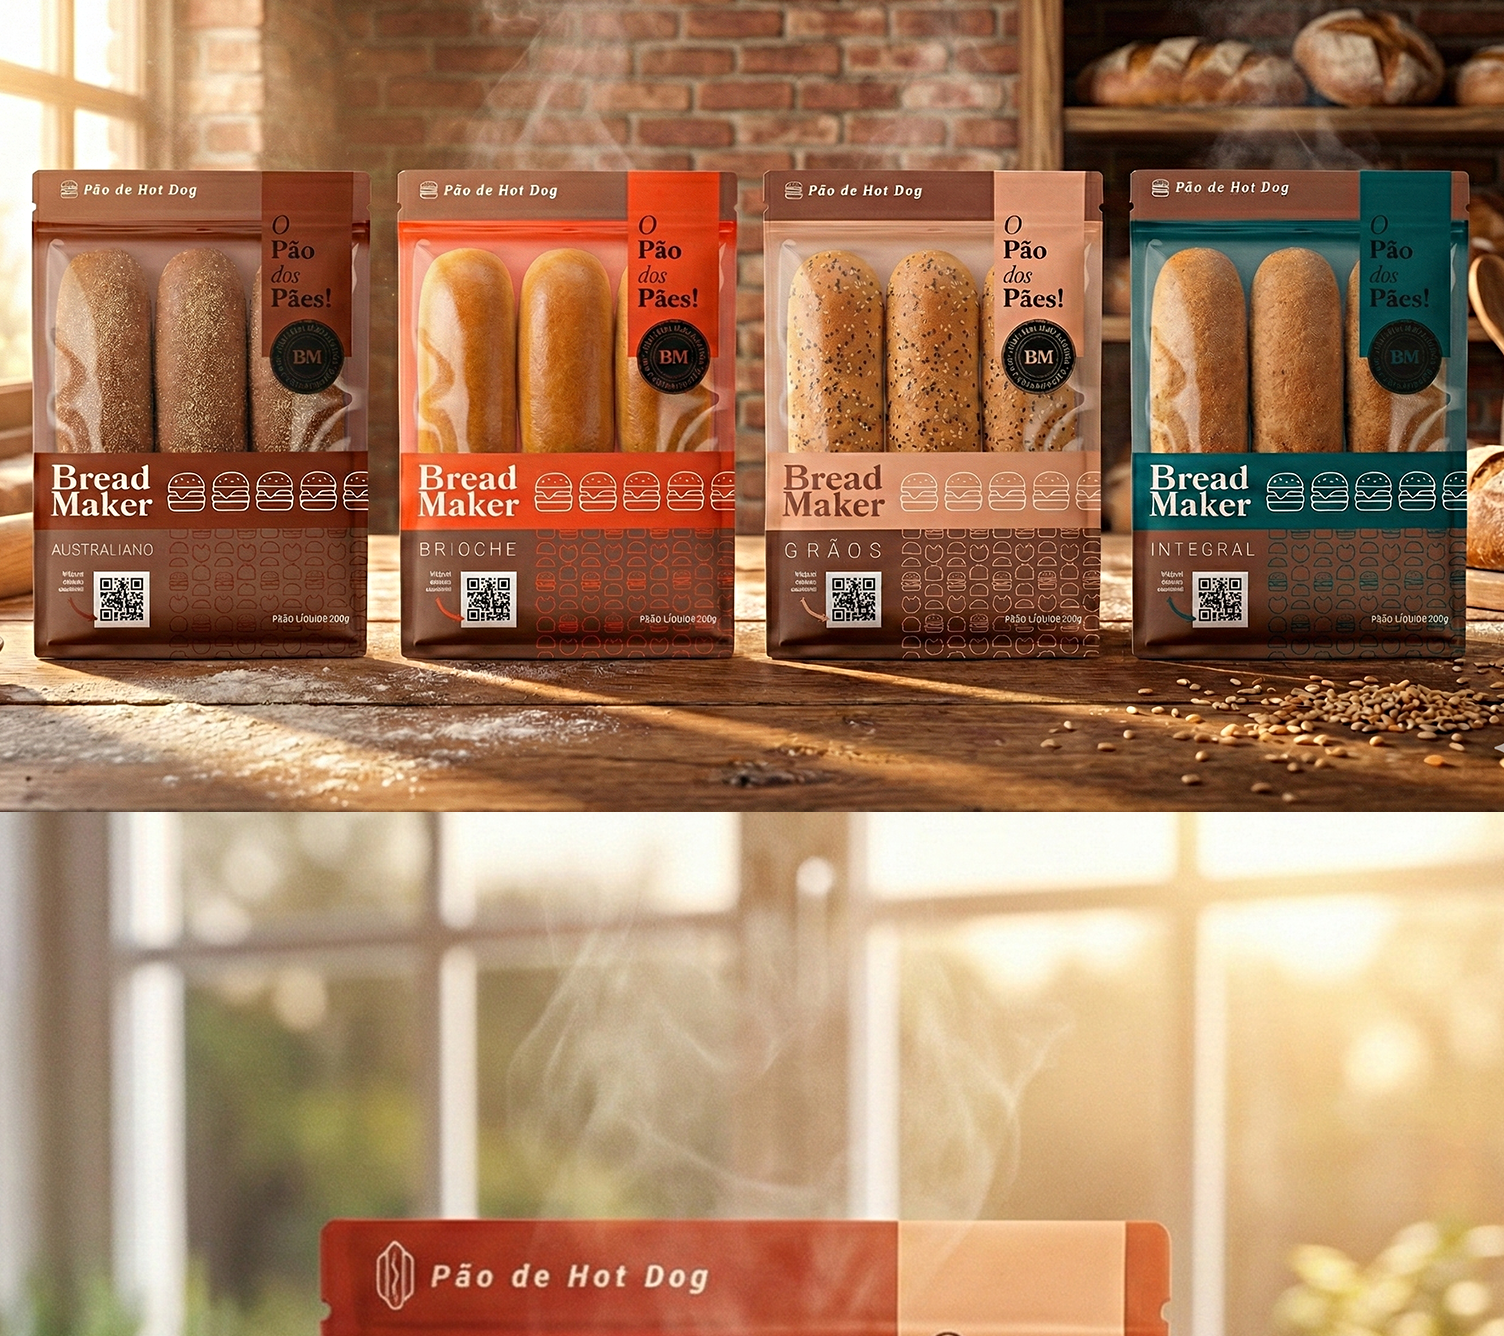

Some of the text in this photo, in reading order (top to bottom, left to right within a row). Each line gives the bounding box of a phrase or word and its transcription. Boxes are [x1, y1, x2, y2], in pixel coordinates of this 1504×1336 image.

[83, 184, 198, 199] Pão de Hot Dog
[443, 184, 558, 199] Pão de Hot Dog
[808, 184, 923, 199] Pão de Hot Dog
[1175, 181, 1289, 196] Pão de Hot Dog
[272, 215, 289, 235] O
[639, 215, 656, 235] O
[1004, 215, 1021, 235] O
[1370, 215, 1387, 235] O
[271, 240, 315, 260] Pão
[638, 240, 682, 260] Pão
[1003, 240, 1047, 260] Pão
[1369, 240, 1413, 260] Pão
[271, 264, 300, 284] dos
[638, 264, 667, 284] dos
[1003, 264, 1032, 284] dos
[1369, 264, 1398, 284] dos
[271, 288, 332, 308] Pães!
[638, 288, 699, 308] Pães!
[1003, 288, 1064, 308] Pães!
[1369, 288, 1430, 308] Pães!
[293, 350, 322, 365] BM
[658, 350, 688, 365] BM
[1024, 350, 1053, 365] BM
[1390, 350, 1419, 365] BM
[51, 464, 150, 491] Bread
[418, 464, 517, 491] Bread
[783, 464, 882, 491] Bread
[1150, 464, 1249, 491] Bread
[50, 491, 153, 517] Maker
[417, 491, 519, 517] Maker
[782, 491, 885, 517] Maker
[1149, 491, 1251, 517] Maker
[51, 543, 154, 557] AUSTRALIANO
[419, 541, 517, 557] BRIOCHE
[784, 538, 882, 559] GRÃOS
[1150, 541, 1255, 557] INTEGRAL
[329, 614, 350, 625] 200g
[696, 614, 717, 625] 200g
[1061, 614, 1082, 625] 200g
[1428, 614, 1449, 625] 200g
[431, 1263, 710, 1294] Pão de Hot Dog
